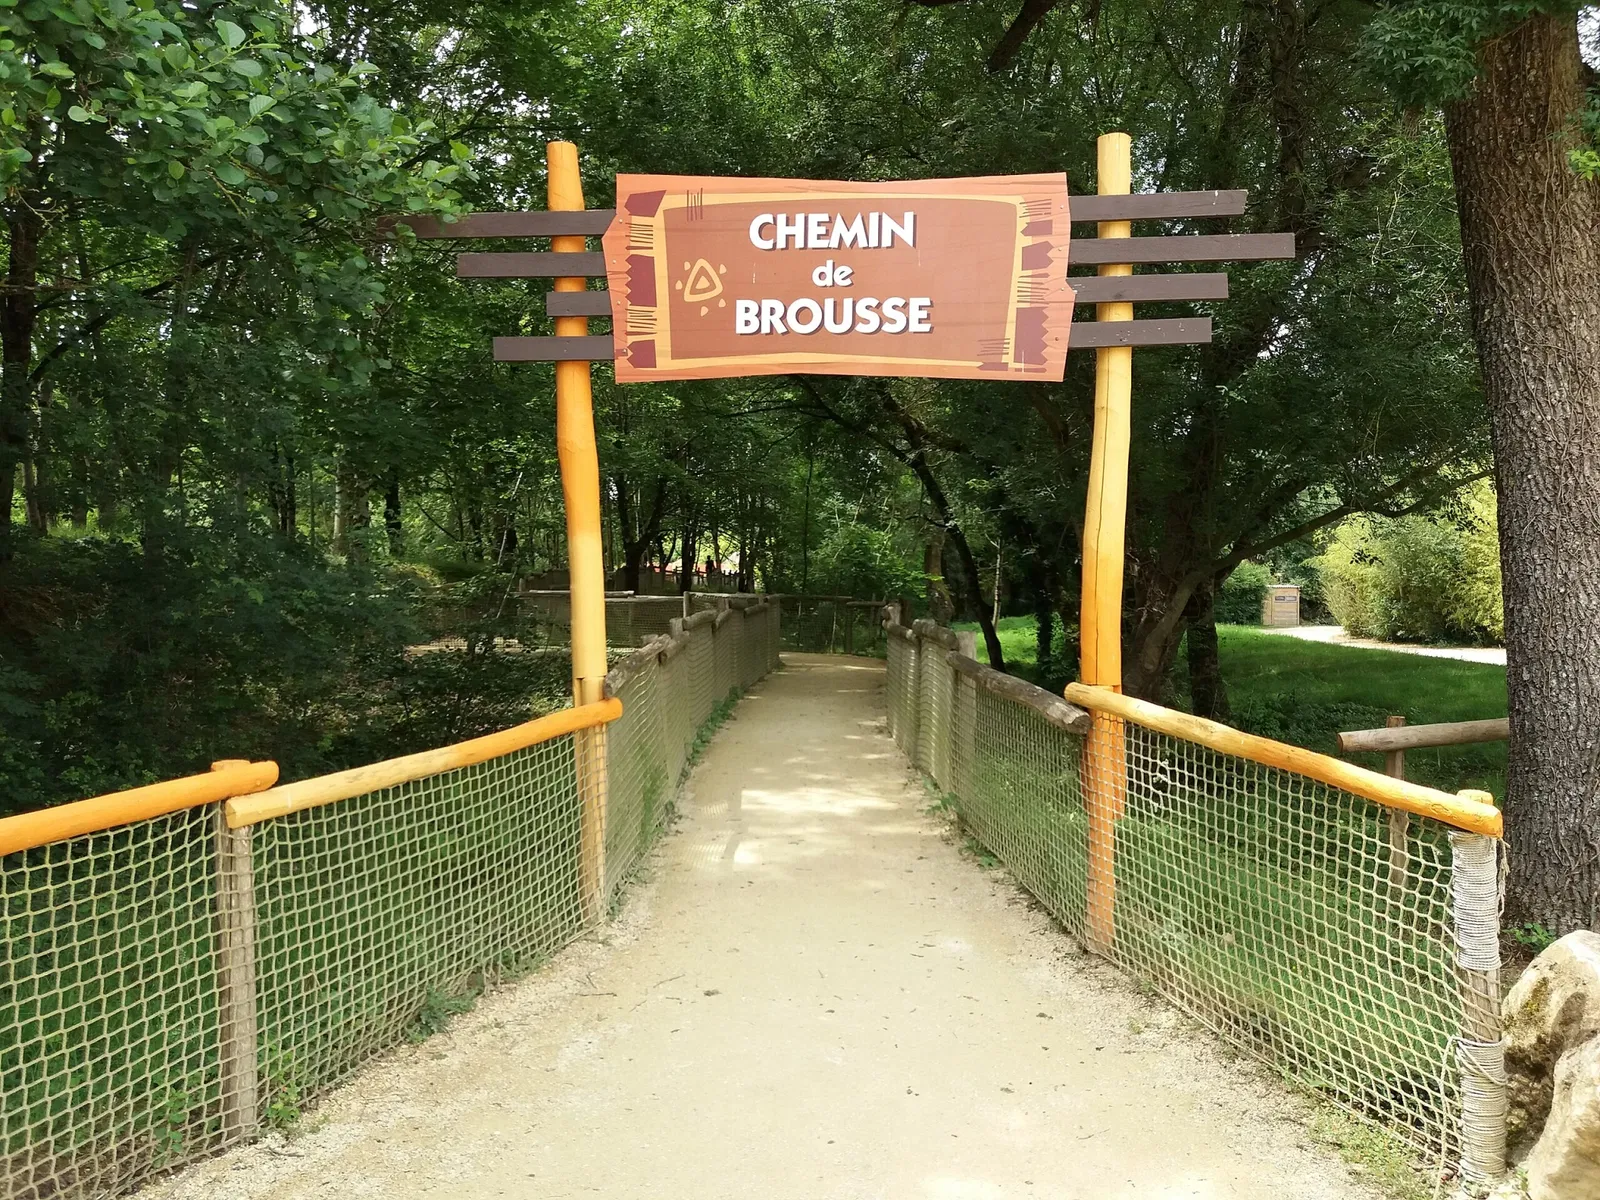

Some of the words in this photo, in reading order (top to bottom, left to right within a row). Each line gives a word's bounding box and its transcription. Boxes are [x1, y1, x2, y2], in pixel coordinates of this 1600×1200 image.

[748, 211, 917, 250] CHEMIN
[811, 259, 853, 287] de
[735, 297, 933, 335] BROUSSE
